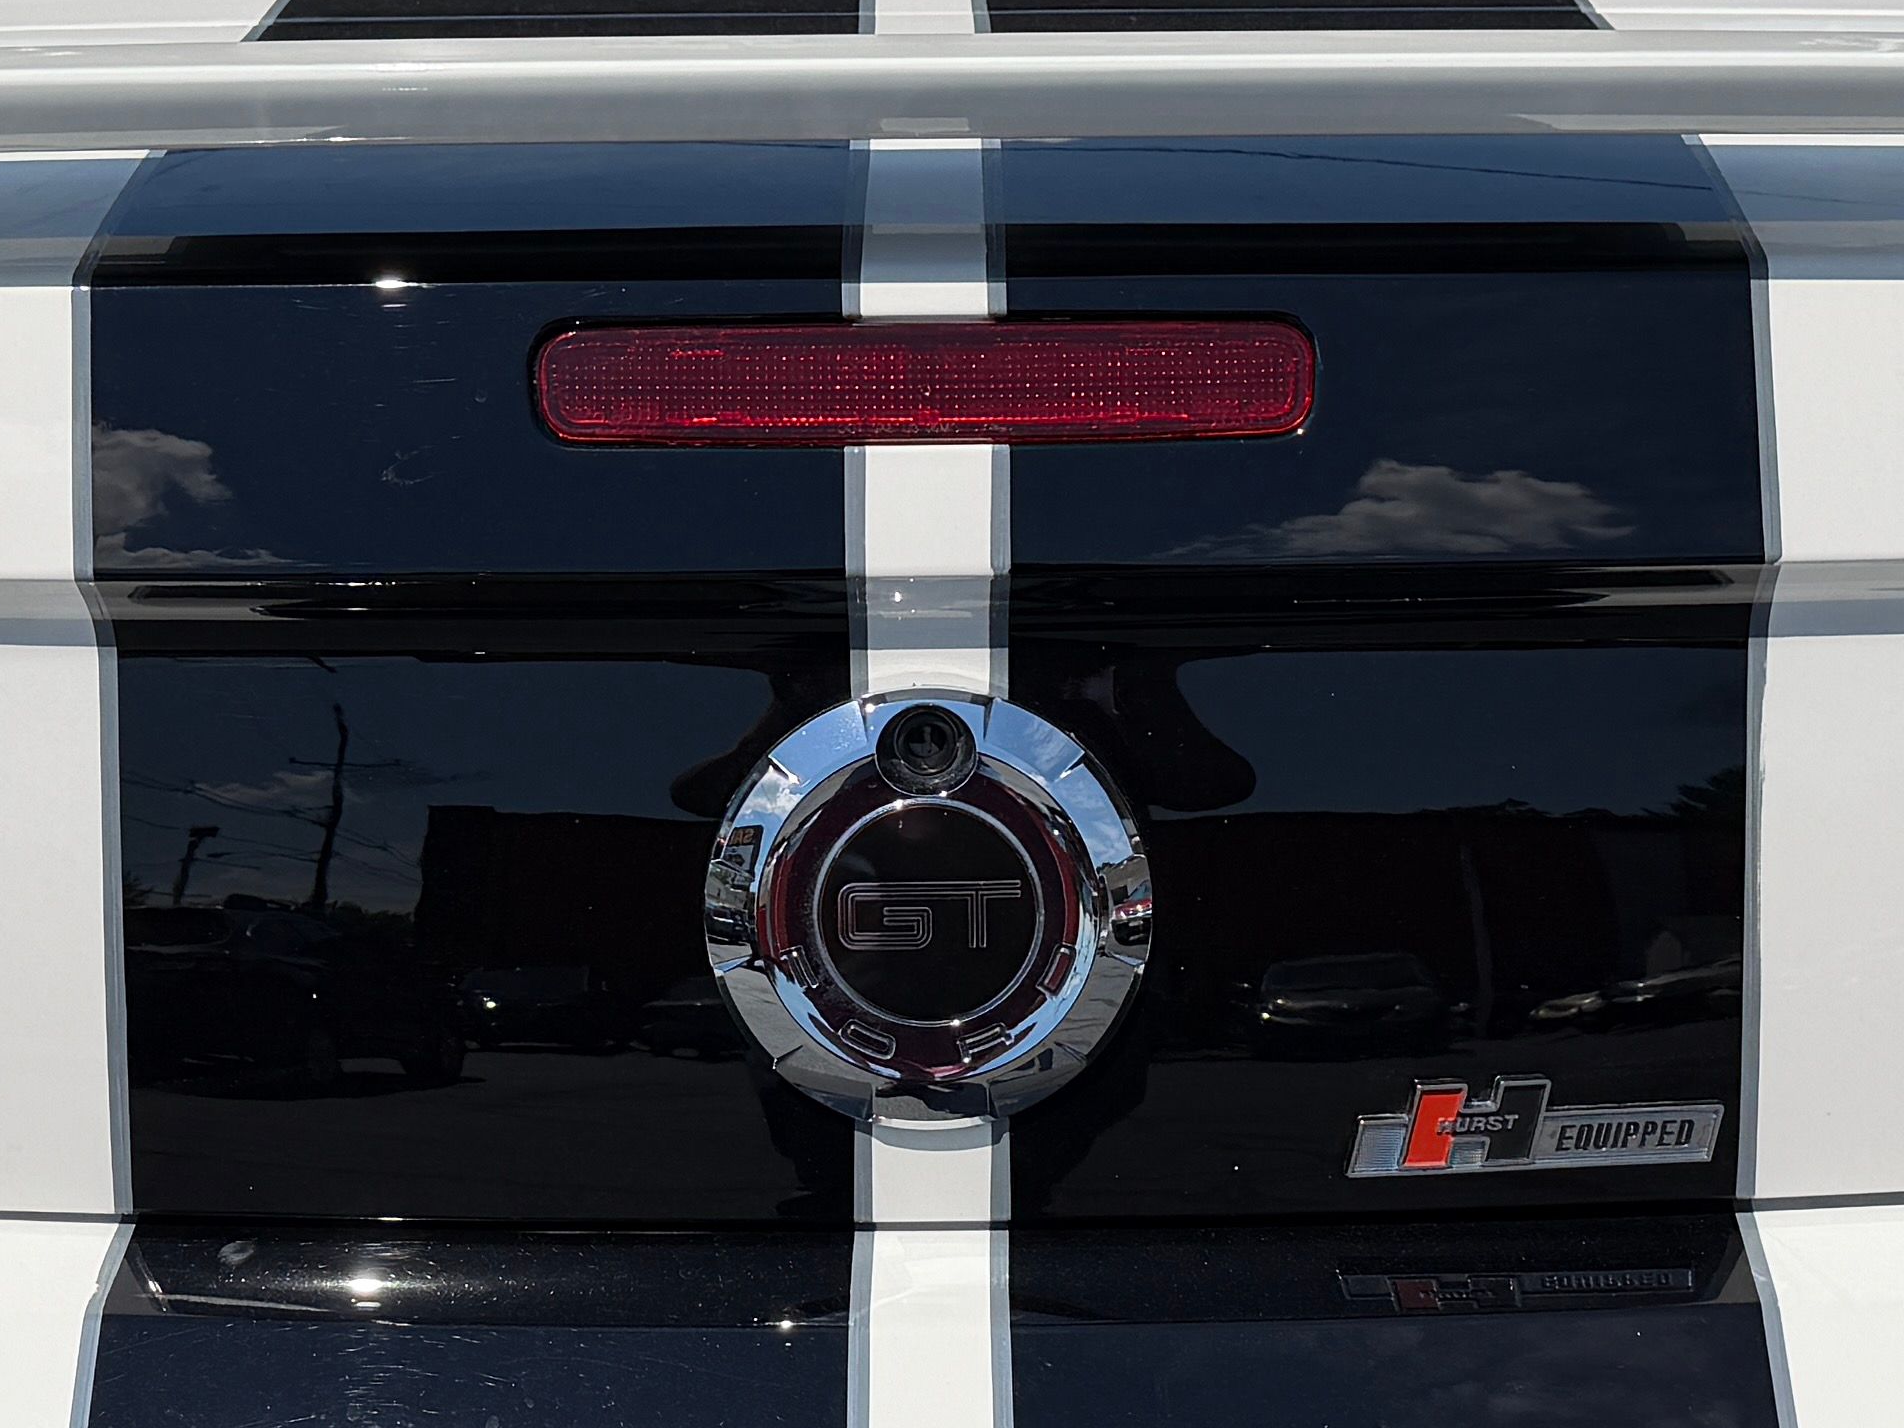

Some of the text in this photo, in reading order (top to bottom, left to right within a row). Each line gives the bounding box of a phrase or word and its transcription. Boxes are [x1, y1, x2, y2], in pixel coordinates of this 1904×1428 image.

[837, 879, 1022, 951] GT
[1436, 1113, 1696, 1153] HURST EQUIPPED
